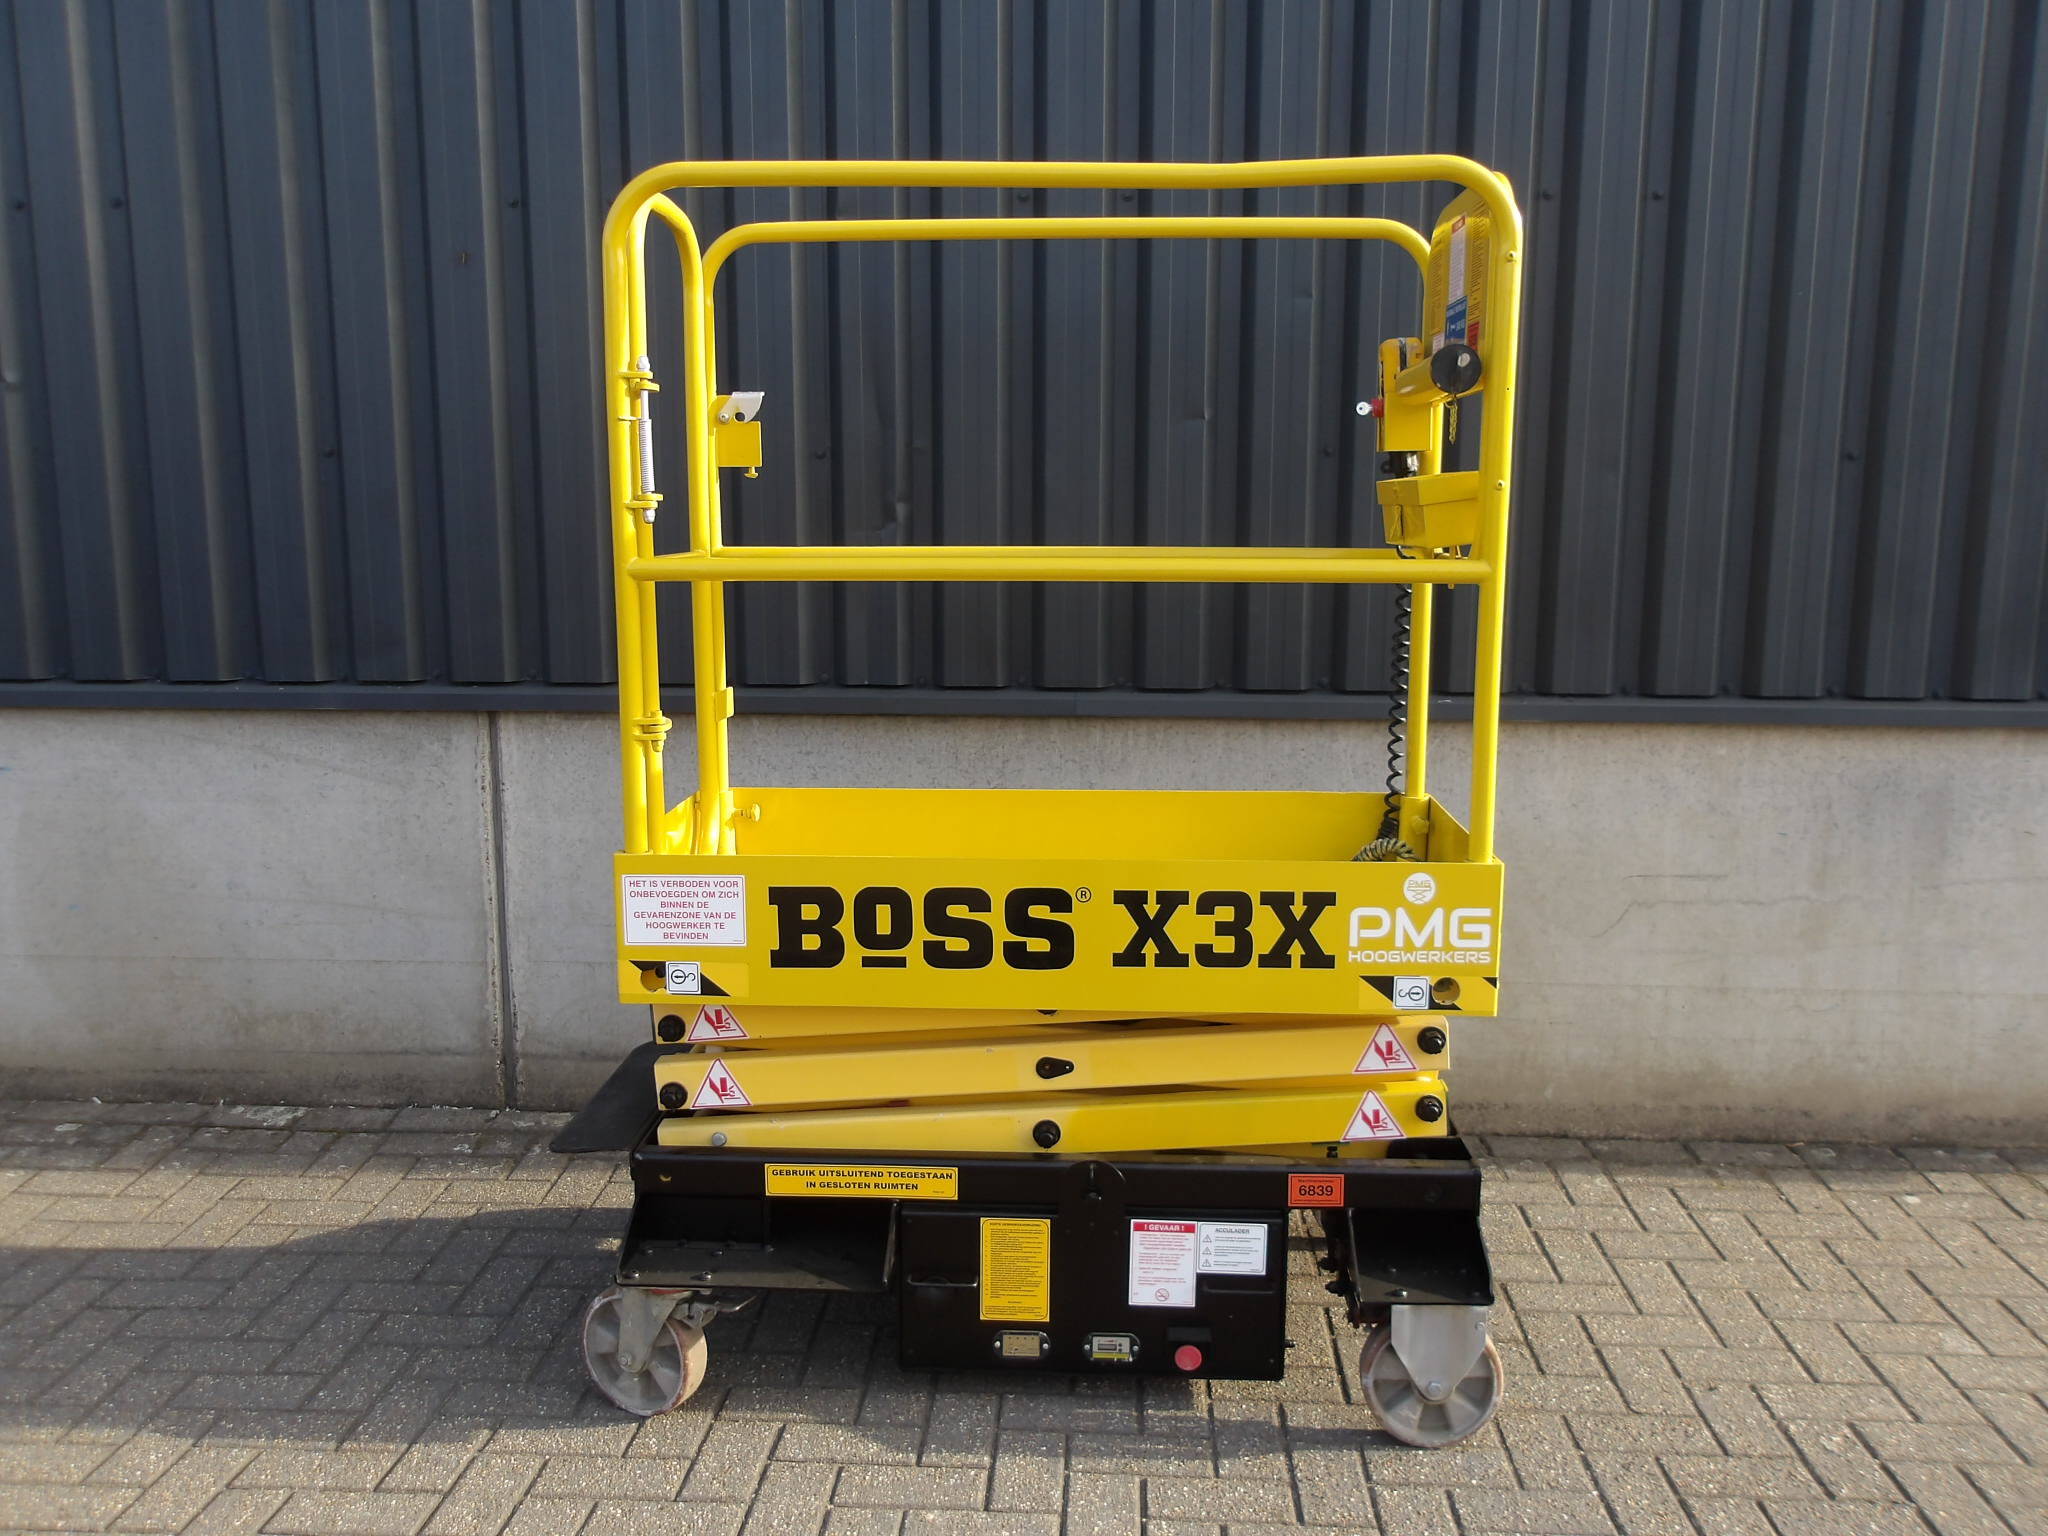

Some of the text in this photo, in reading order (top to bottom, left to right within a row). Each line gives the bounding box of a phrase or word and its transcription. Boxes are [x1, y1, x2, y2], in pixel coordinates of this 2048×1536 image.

[629, 880, 739, 888] HET IS VERBODEN VOOR
[629, 890, 699, 898] ONBEVOEGDEN
[633, 911, 700, 919] GEVARENZONE
[645, 921, 711, 930] HOOGWERKER
[1112, 889, 1337, 969] X3X
[1349, 907, 1492, 948] PMG
[663, 932, 709, 940] BEVINDEN
[1348, 950, 1491, 963] HOOGWERKERS
[772, 1169, 953, 1180] GEBRUIK UITSLUITEND TOEGESTAAN
[819, 1181, 871, 1189] GESLOTEN
[873, 1182, 919, 1190] RUIMTEN
[1299, 1185, 1334, 1196] 6839
[1148, 1223, 1180, 1232] GEVAAR
